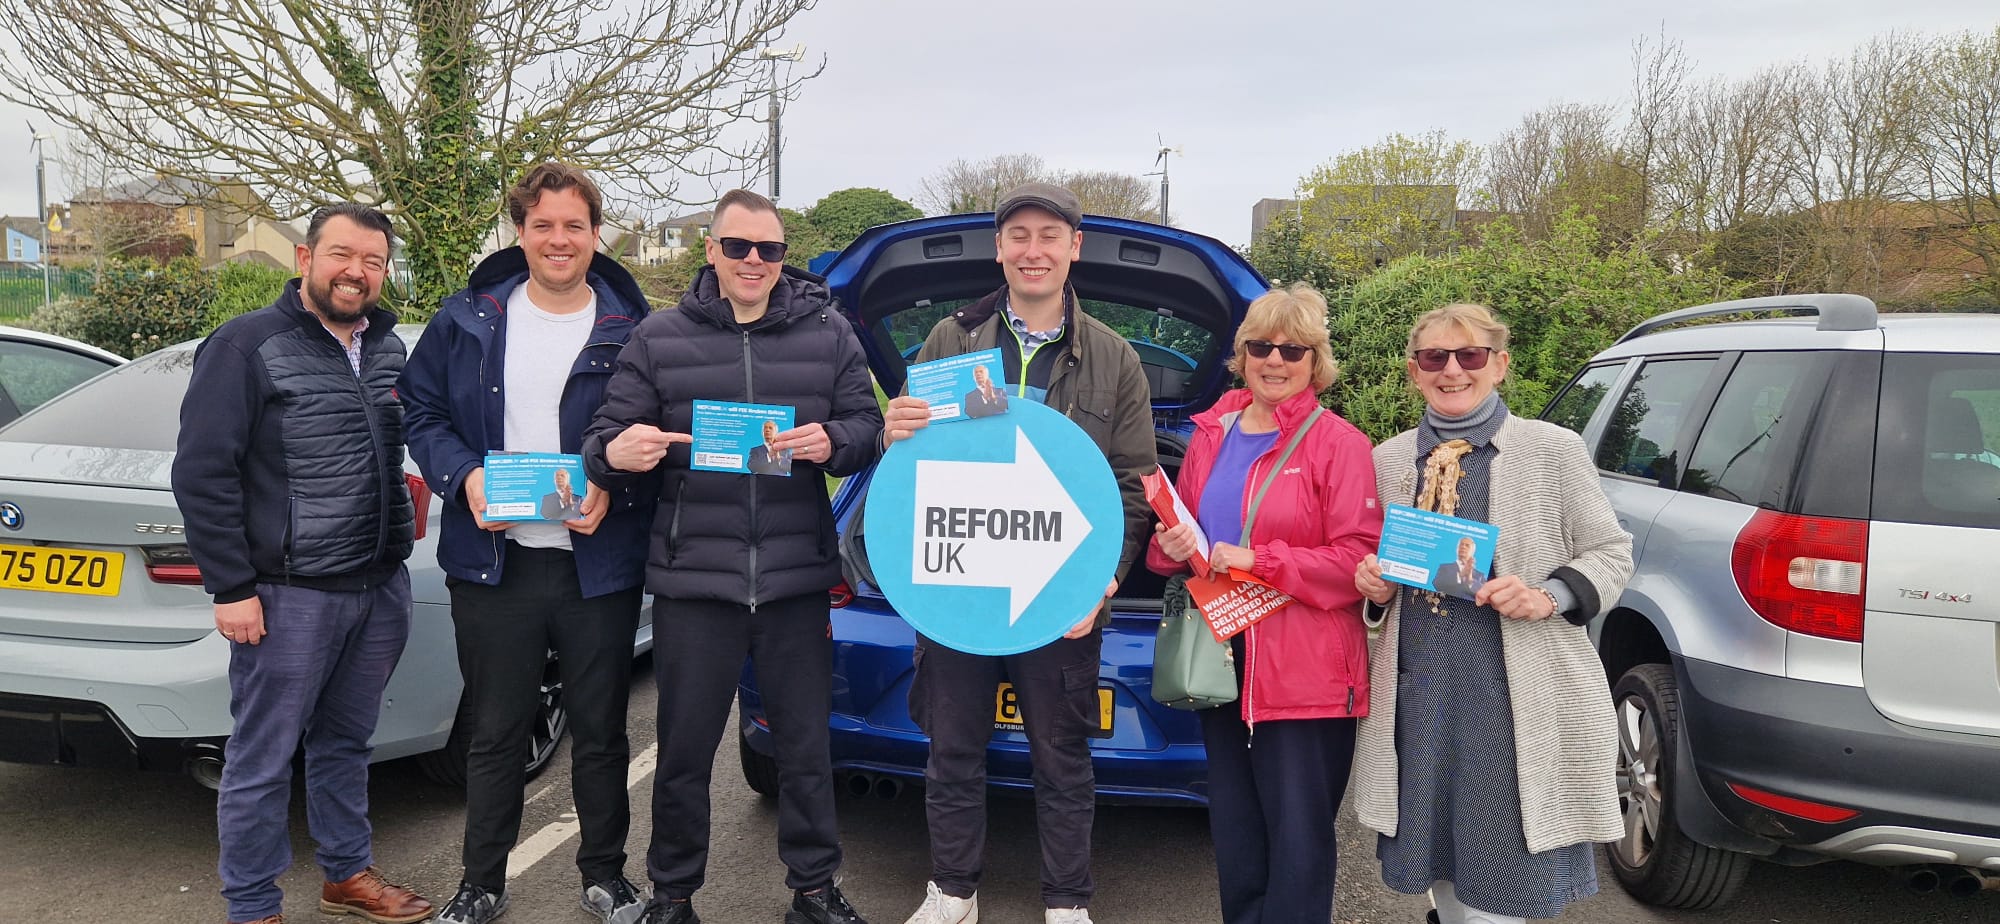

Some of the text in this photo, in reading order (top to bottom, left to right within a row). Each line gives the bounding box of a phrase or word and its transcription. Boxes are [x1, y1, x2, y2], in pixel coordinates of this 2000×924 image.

[135, 522, 185, 534] 330
[925, 506, 1062, 542] REFORM
[1, 550, 109, 588] 75 OZO
[924, 541, 966, 574] UK
[1203, 593, 1229, 612] WHAT
[1230, 590, 1238, 598] A
[1207, 585, 1265, 620] COUNCIL HAS
[1212, 589, 1280, 630] DELIVERED FOR
[1898, 588, 1972, 603] TSI 4x4
[1216, 623, 1237, 638] YOU
[1237, 616, 1249, 628] IN
